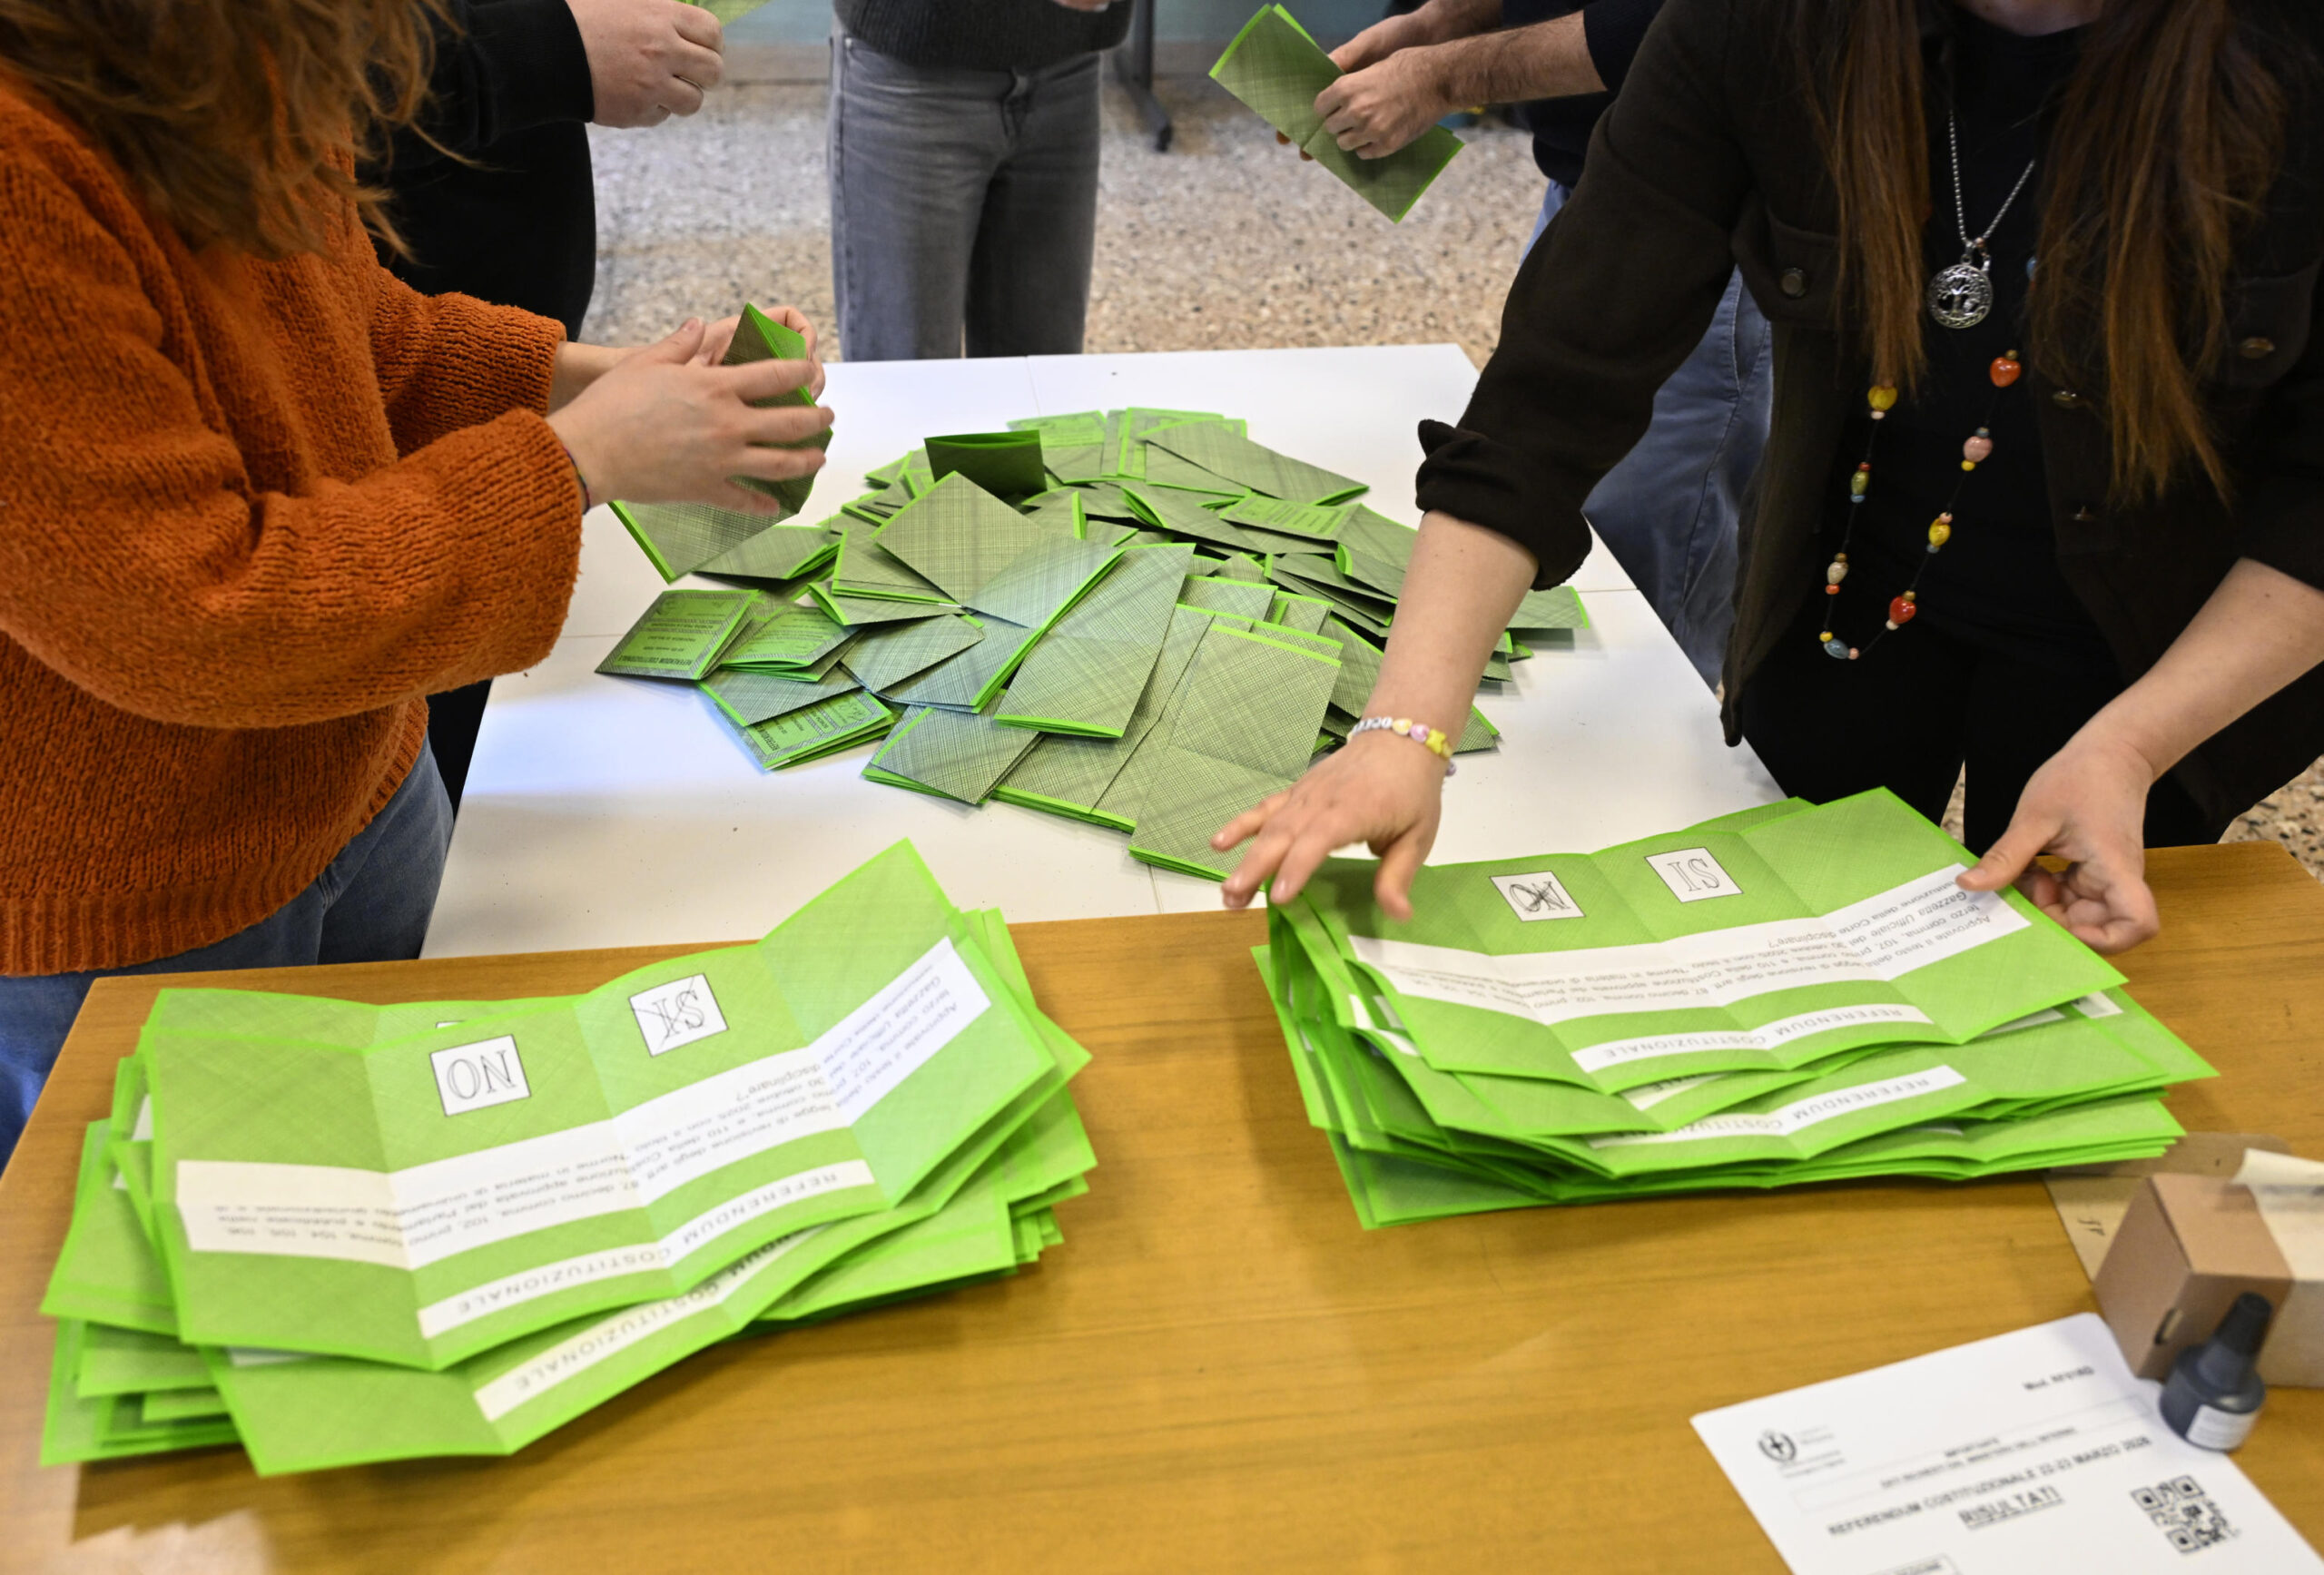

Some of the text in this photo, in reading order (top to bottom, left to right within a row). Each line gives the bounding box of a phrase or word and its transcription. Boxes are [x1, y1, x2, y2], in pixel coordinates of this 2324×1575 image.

[1667, 858, 1720, 891] SI
[1871, 904, 1898, 922] della
[1917, 890, 1966, 918] Gazzetta
[1950, 901, 1980, 921] terzo
[1838, 918, 1870, 936] Corte
[1847, 934, 1866, 947] del
[1869, 912, 1915, 940] Ufficiale
[1935, 913, 1990, 945] Approvate
[1865, 953, 1892, 969] della
[1895, 941, 1923, 958] testo
[892, 973, 942, 1019] Gazzetta
[920, 988, 950, 1017] terzo
[651, 989, 706, 1039] SI
[902, 1000, 959, 1052] Approvate
[1603, 1007, 1902, 1058] REFERENDUM COSTITUZIONALE
[448, 1049, 516, 1098] NO
[864, 1058, 892, 1086] testo
[1792, 1077, 1929, 1120] REFERENDUM
[681, 1171, 838, 1245] REFERENDUM
[456, 1245, 672, 1315] COSTITUZIONALE
[1827, 1499, 1923, 1538] REFERENDUM
[1923, 1465, 2036, 1511] COSTITUZIONALE
[2071, 1442, 2120, 1467] MARZO
[1956, 1481, 2062, 1528] RISULTATI
